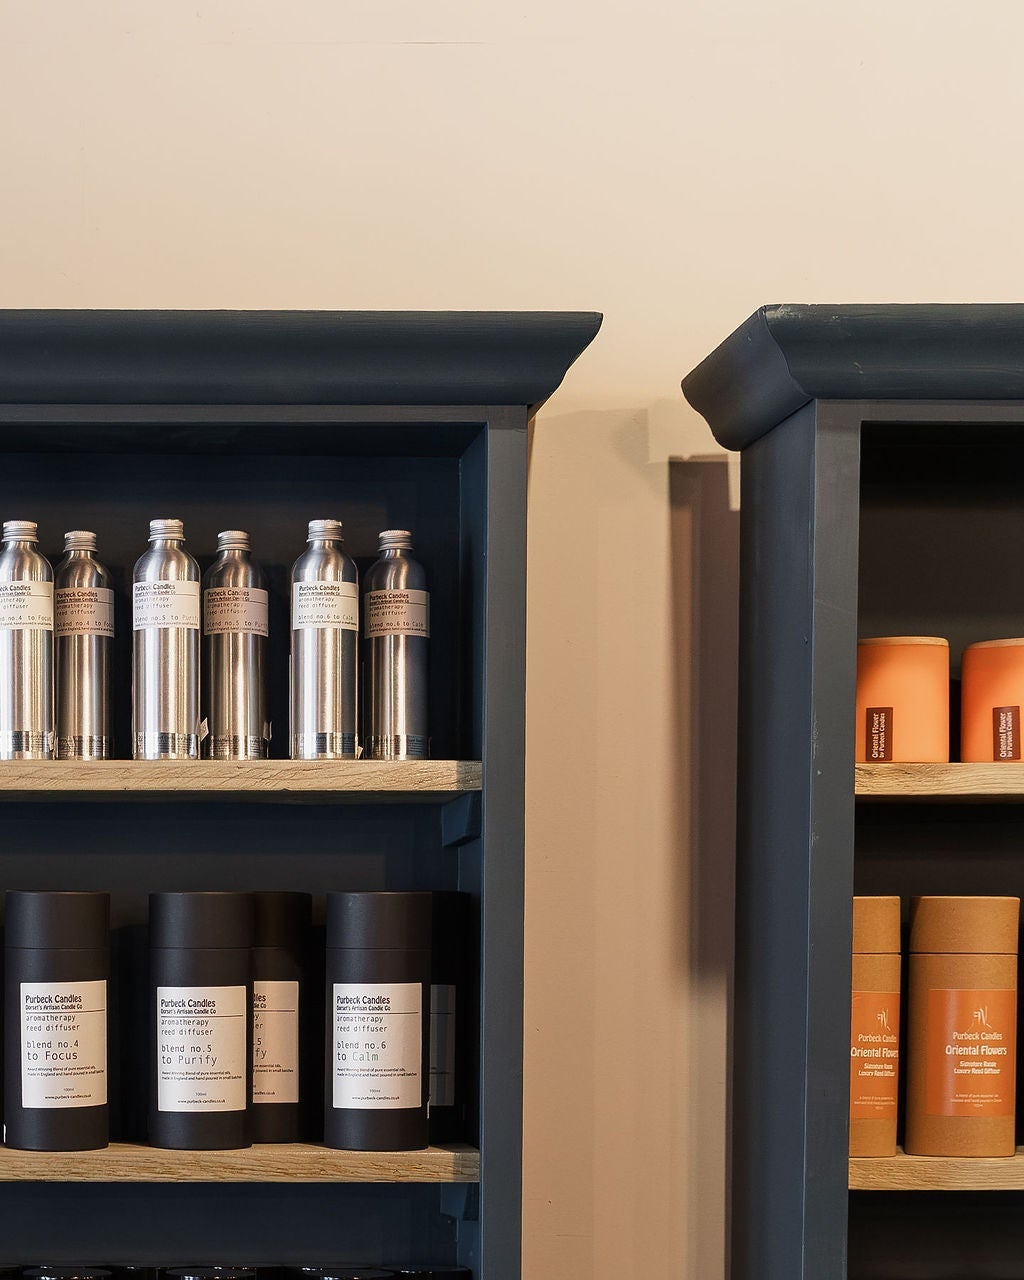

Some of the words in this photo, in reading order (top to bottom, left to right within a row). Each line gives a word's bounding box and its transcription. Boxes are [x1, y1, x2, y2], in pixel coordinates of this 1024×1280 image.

[26, 994, 53, 1003] Purbeck
[55, 994, 82, 1003] Candles
[337, 996, 360, 1004] Purbeck
[362, 996, 390, 1004] Candles
[160, 999, 186, 1008] Purbeck
[188, 999, 216, 1008] Candles
[161, 1019, 208, 1027] aromatherapy
[161, 1028, 176, 1036] reed
[179, 1028, 213, 1036] diffuser
[953, 1032, 979, 1040] Purbeck
[981, 1032, 1002, 1040] Candles
[27, 1040, 52, 1048] blend
[58, 1040, 79, 1048] no.4
[161, 1044, 184, 1052] blend
[190, 1045, 212, 1053] no.5
[337, 1041, 359, 1049] blend
[365, 1041, 386, 1049] no.6
[945, 1045, 978, 1056] Oriental
[981, 1046, 1007, 1056] Flowers
[27, 1052, 38, 1061] to
[45, 1051, 77, 1060] Focus
[162, 1056, 172, 1064] to
[178, 1055, 217, 1066] Purify
[337, 1052, 346, 1061] to
[353, 1052, 379, 1061] Calm
